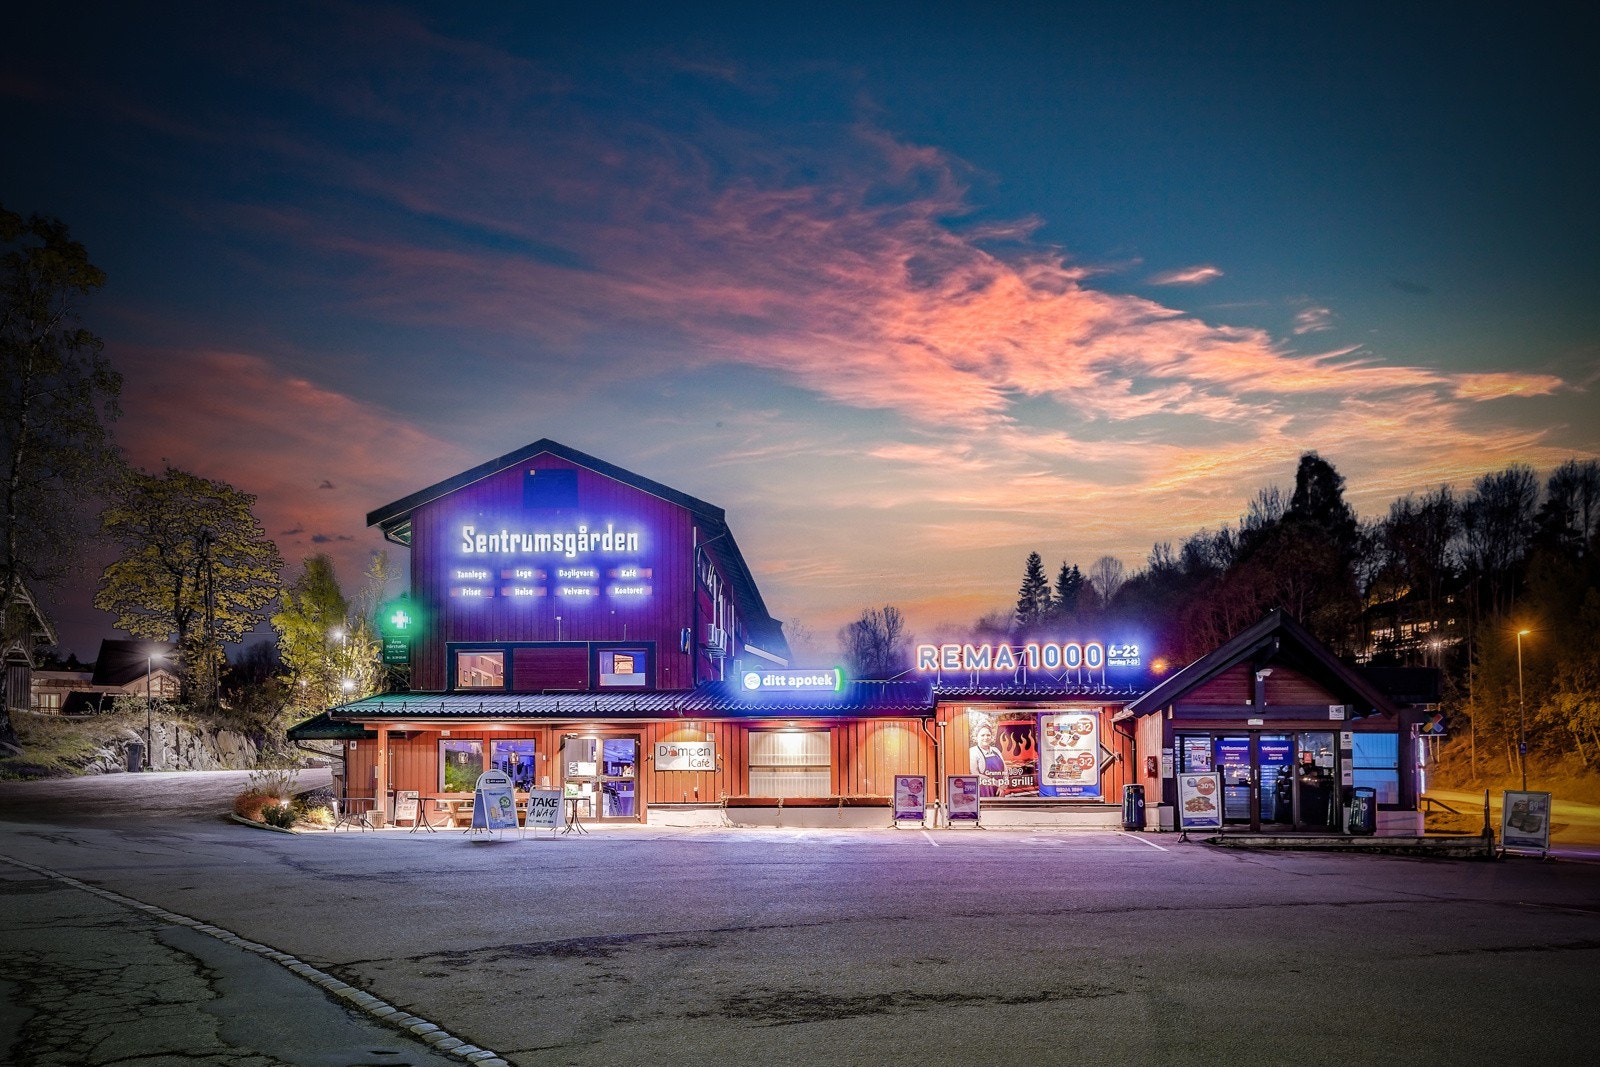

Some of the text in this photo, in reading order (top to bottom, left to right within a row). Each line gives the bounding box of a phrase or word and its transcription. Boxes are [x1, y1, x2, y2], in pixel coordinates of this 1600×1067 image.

[462, 524, 638, 558] Sentrumsgården
[457, 571, 487, 579] Tannlege
[516, 570, 532, 578] Lege
[559, 569, 594, 578] Dagligvare
[621, 569, 637, 577] Kafé
[462, 588, 482, 596] Frisør
[515, 588, 533, 596] Helse
[563, 588, 590, 596] Velvære
[614, 587, 643, 595] Kontorer
[1109, 644, 1139, 657] 6-23
[917, 643, 1103, 669] REMA 1000
[762, 674, 833, 688] ditt apotek
[691, 758, 710, 768] Café
[998, 775, 1010, 787] på
[1011, 776, 1034, 787] grill!
[531, 797, 559, 808] TAKE
